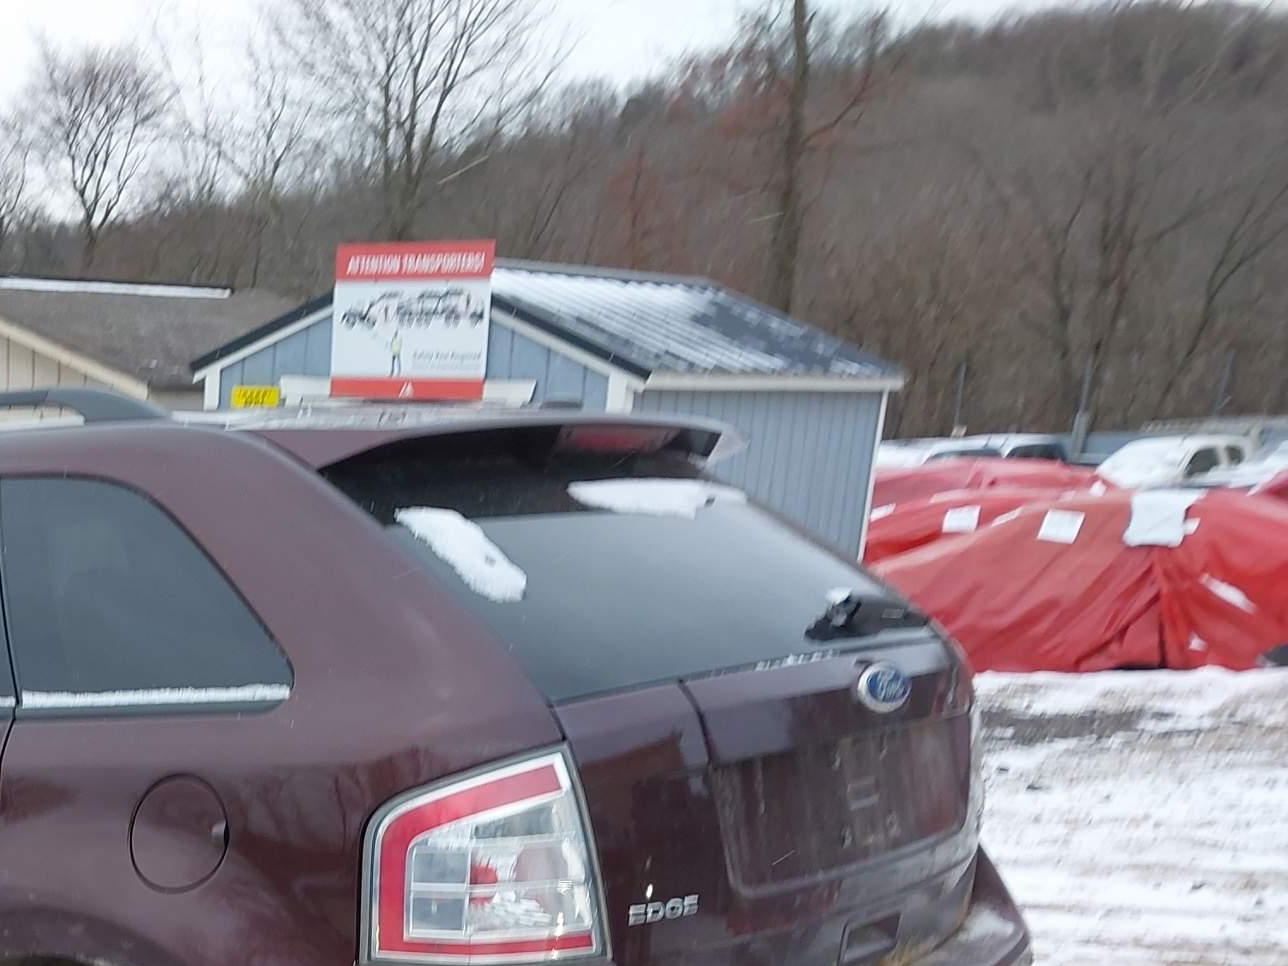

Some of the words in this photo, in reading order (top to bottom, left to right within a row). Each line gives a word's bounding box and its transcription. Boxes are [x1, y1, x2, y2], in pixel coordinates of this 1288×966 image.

[346, 254, 402, 275] ATTENTION
[403, 251, 486, 274] TRANSPORTERS!
[628, 894, 699, 927] EDGE
